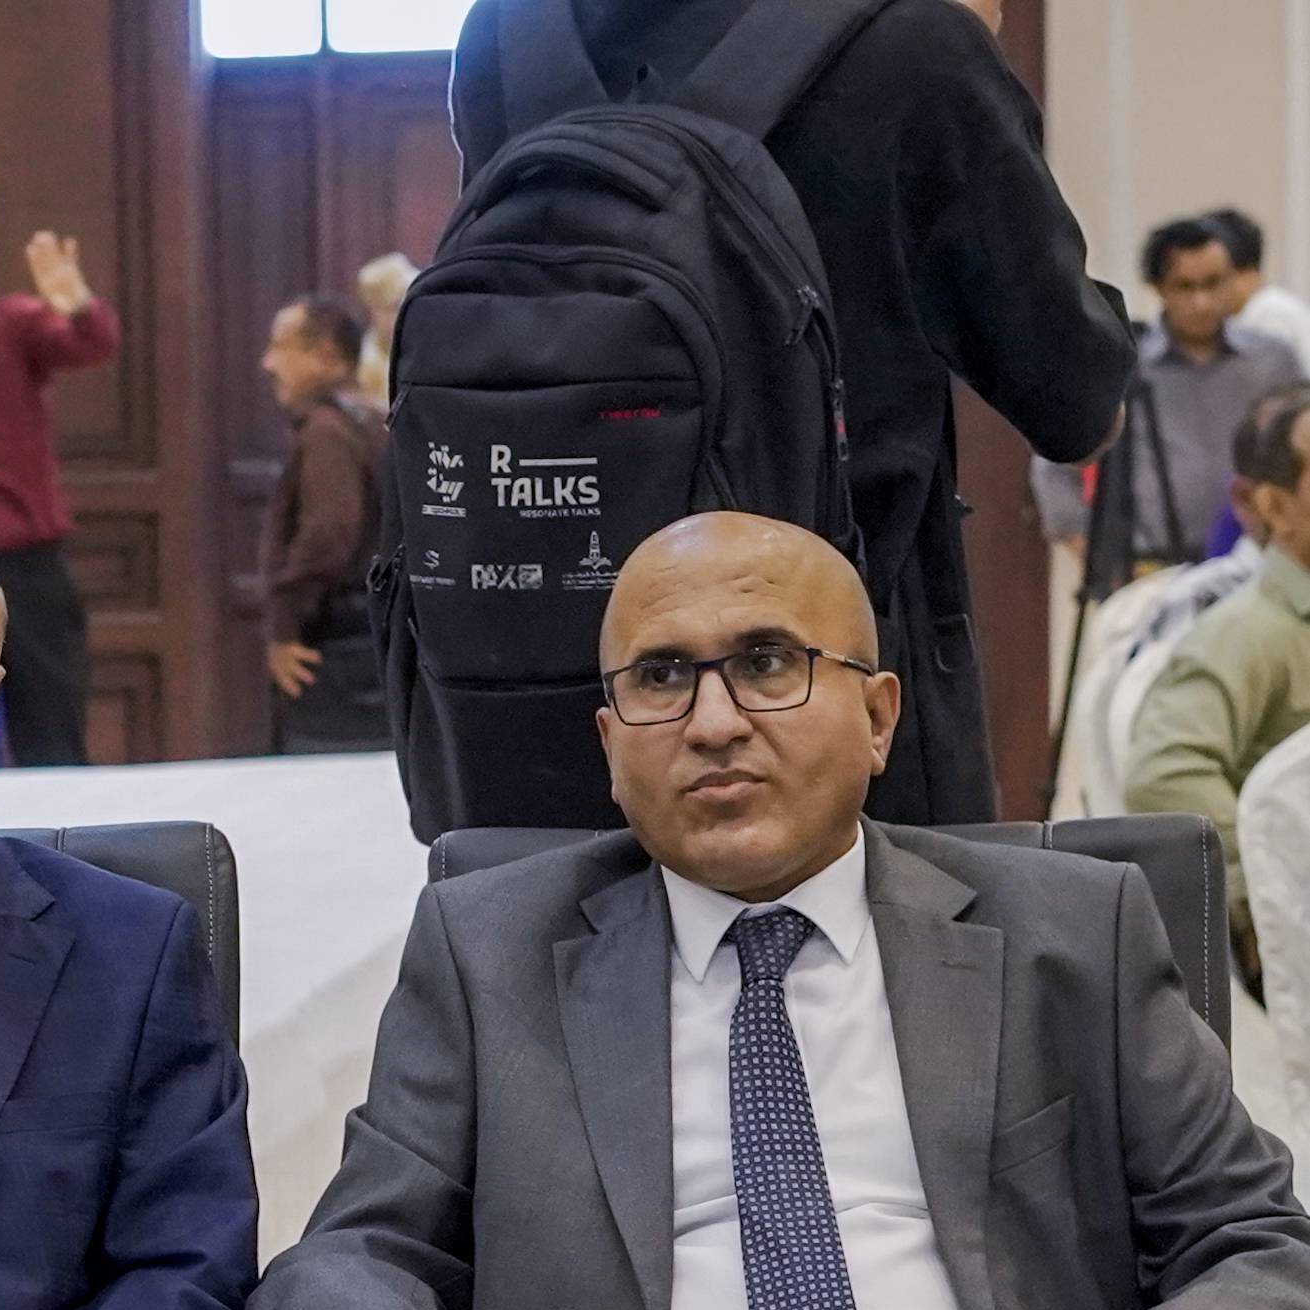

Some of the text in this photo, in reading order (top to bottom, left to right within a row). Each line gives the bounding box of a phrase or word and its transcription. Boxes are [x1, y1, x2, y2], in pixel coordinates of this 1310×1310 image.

[490, 444, 512, 474] R
[490, 475, 601, 507] TALKS
[571, 507, 602, 517] TALKS
